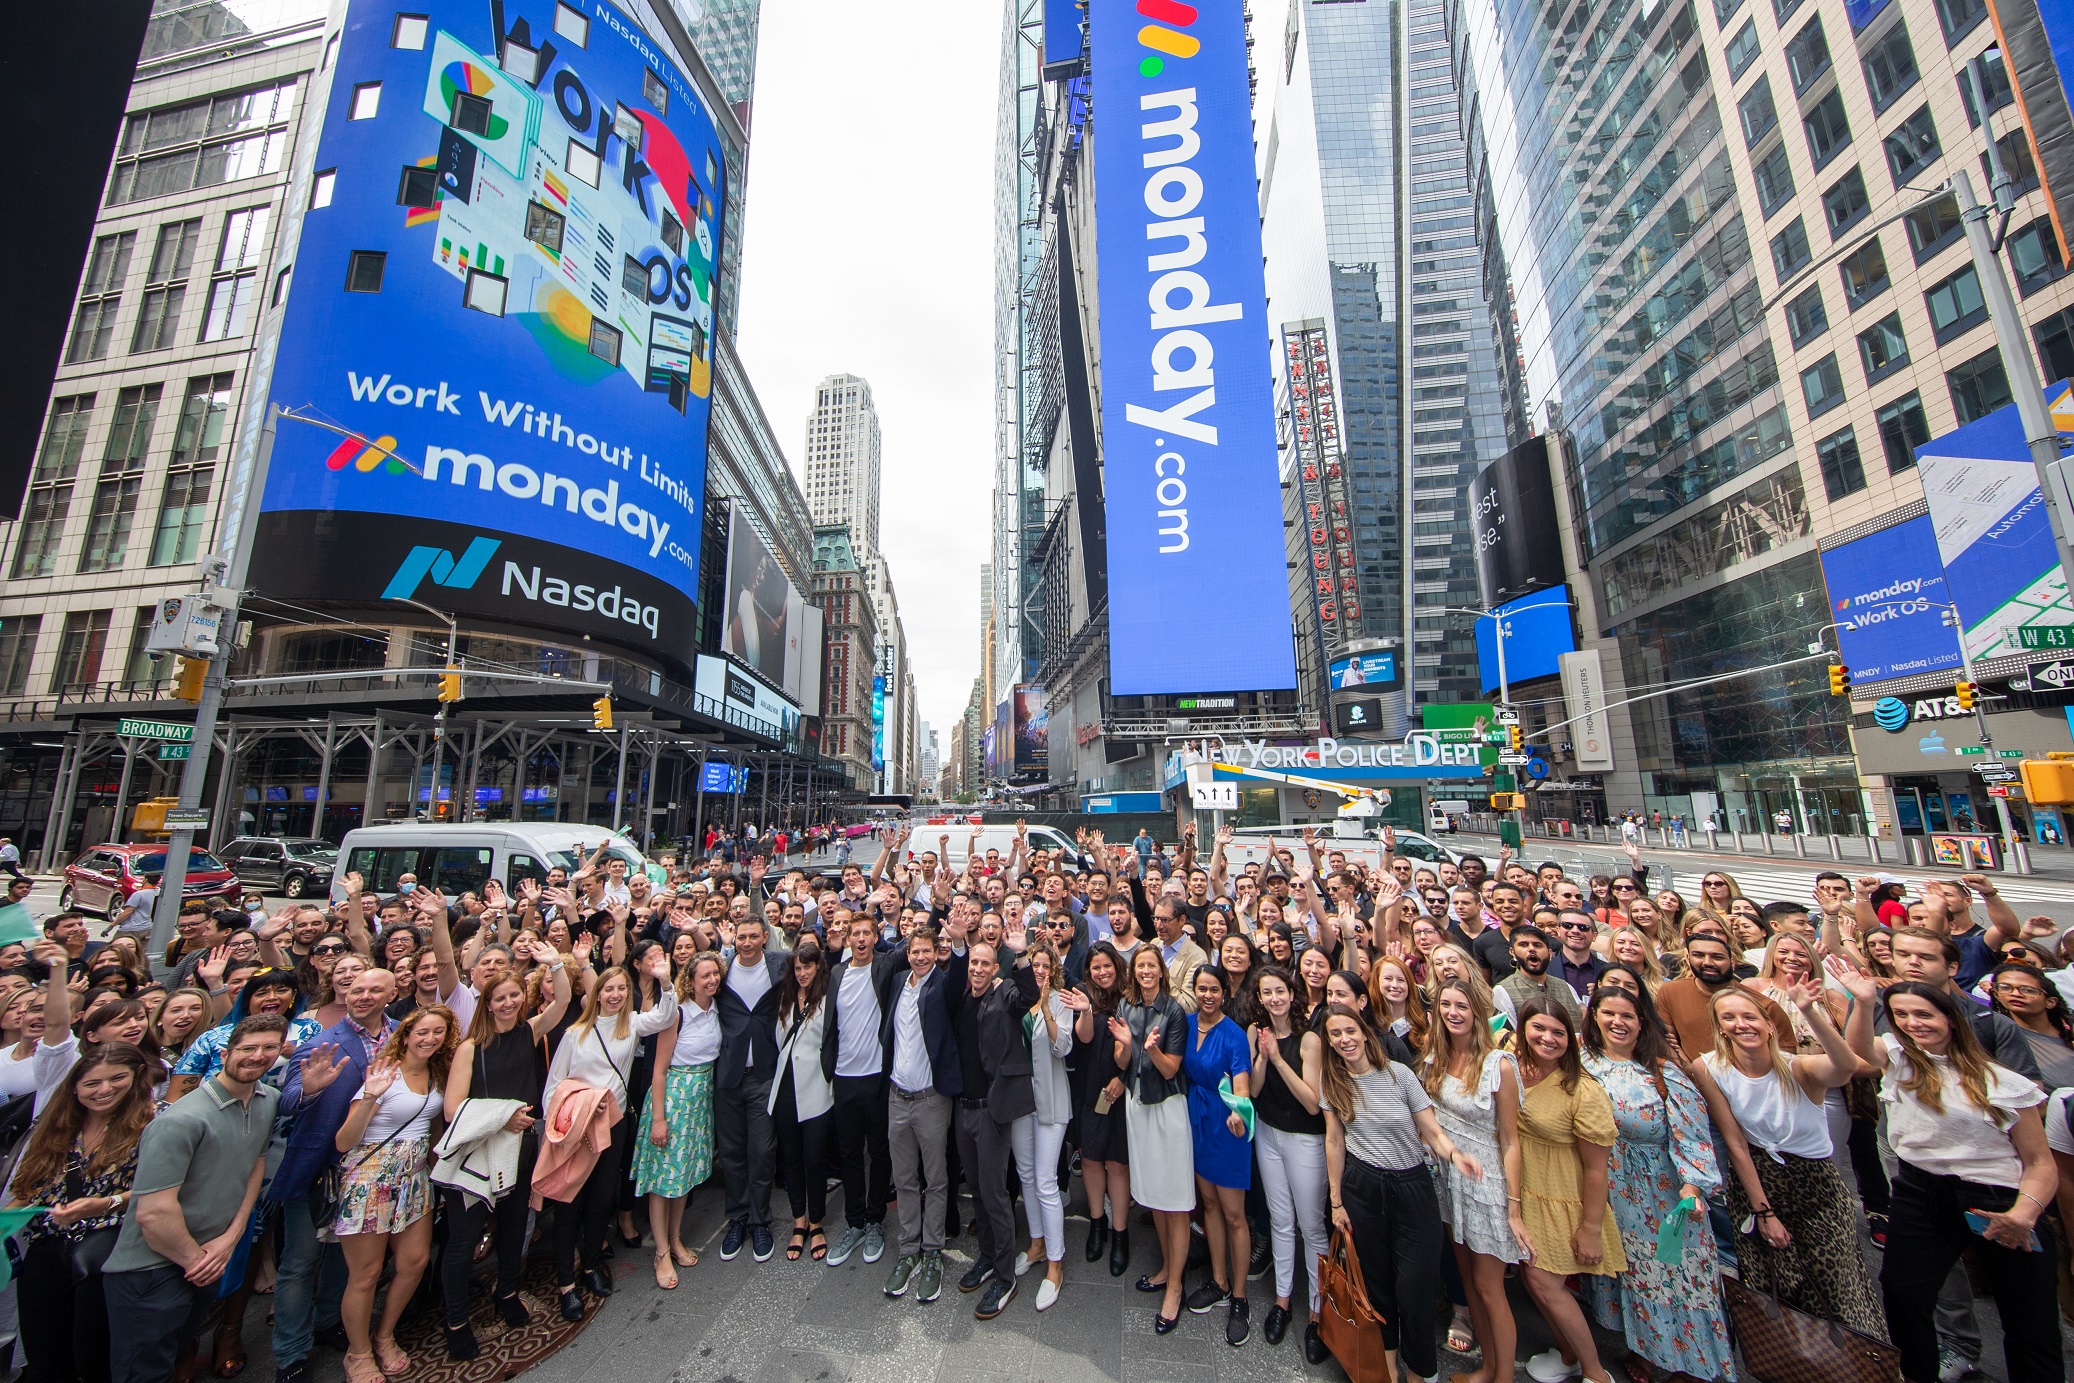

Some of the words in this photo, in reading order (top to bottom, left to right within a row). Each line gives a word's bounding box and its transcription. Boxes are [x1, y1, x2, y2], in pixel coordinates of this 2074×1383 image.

[595, 4, 659, 71] Nasdaq
[661, 63, 698, 116] Listed
[649, 254, 692, 312] OS
[1126, 86, 1244, 555] monday.com
[1290, 341, 1310, 442] ERNST
[347, 371, 462, 416] Work
[478, 390, 634, 472] Without
[640, 454, 695, 515] Limits
[1304, 464, 1317, 481] &
[423, 444, 694, 571] monday.com
[1308, 502, 1336, 621] YOUNG
[502, 560, 659, 640] Nasdaq
[1854, 577, 1943, 606] monday.com
[191, 615, 217, 628] 726156
[1853, 605, 1900, 627] Work
[1901, 596, 1930, 615] OS
[2022, 629, 2039, 646] W
[2047, 629, 2067, 646] 43
[1853, 666, 1881, 679] MNDY
[1891, 658, 1928, 672] Nasdaq
[1927, 652, 1959, 665] Listed
[2047, 667, 2074, 681] ON
[1580, 668, 1592, 700] REUTERS
[1584, 700, 1595, 736] THOMSON
[1914, 696, 1976, 720] AT&
[121, 721, 190, 739] BROADWAY
[161, 747, 168, 758] W
[171, 747, 183, 758] 43
[1244, 738, 1316, 769] YORK
[1318, 737, 1404, 767] POLICE
[1413, 735, 1482, 767] DEPT
[1544, 781, 1592, 790] CHASE
